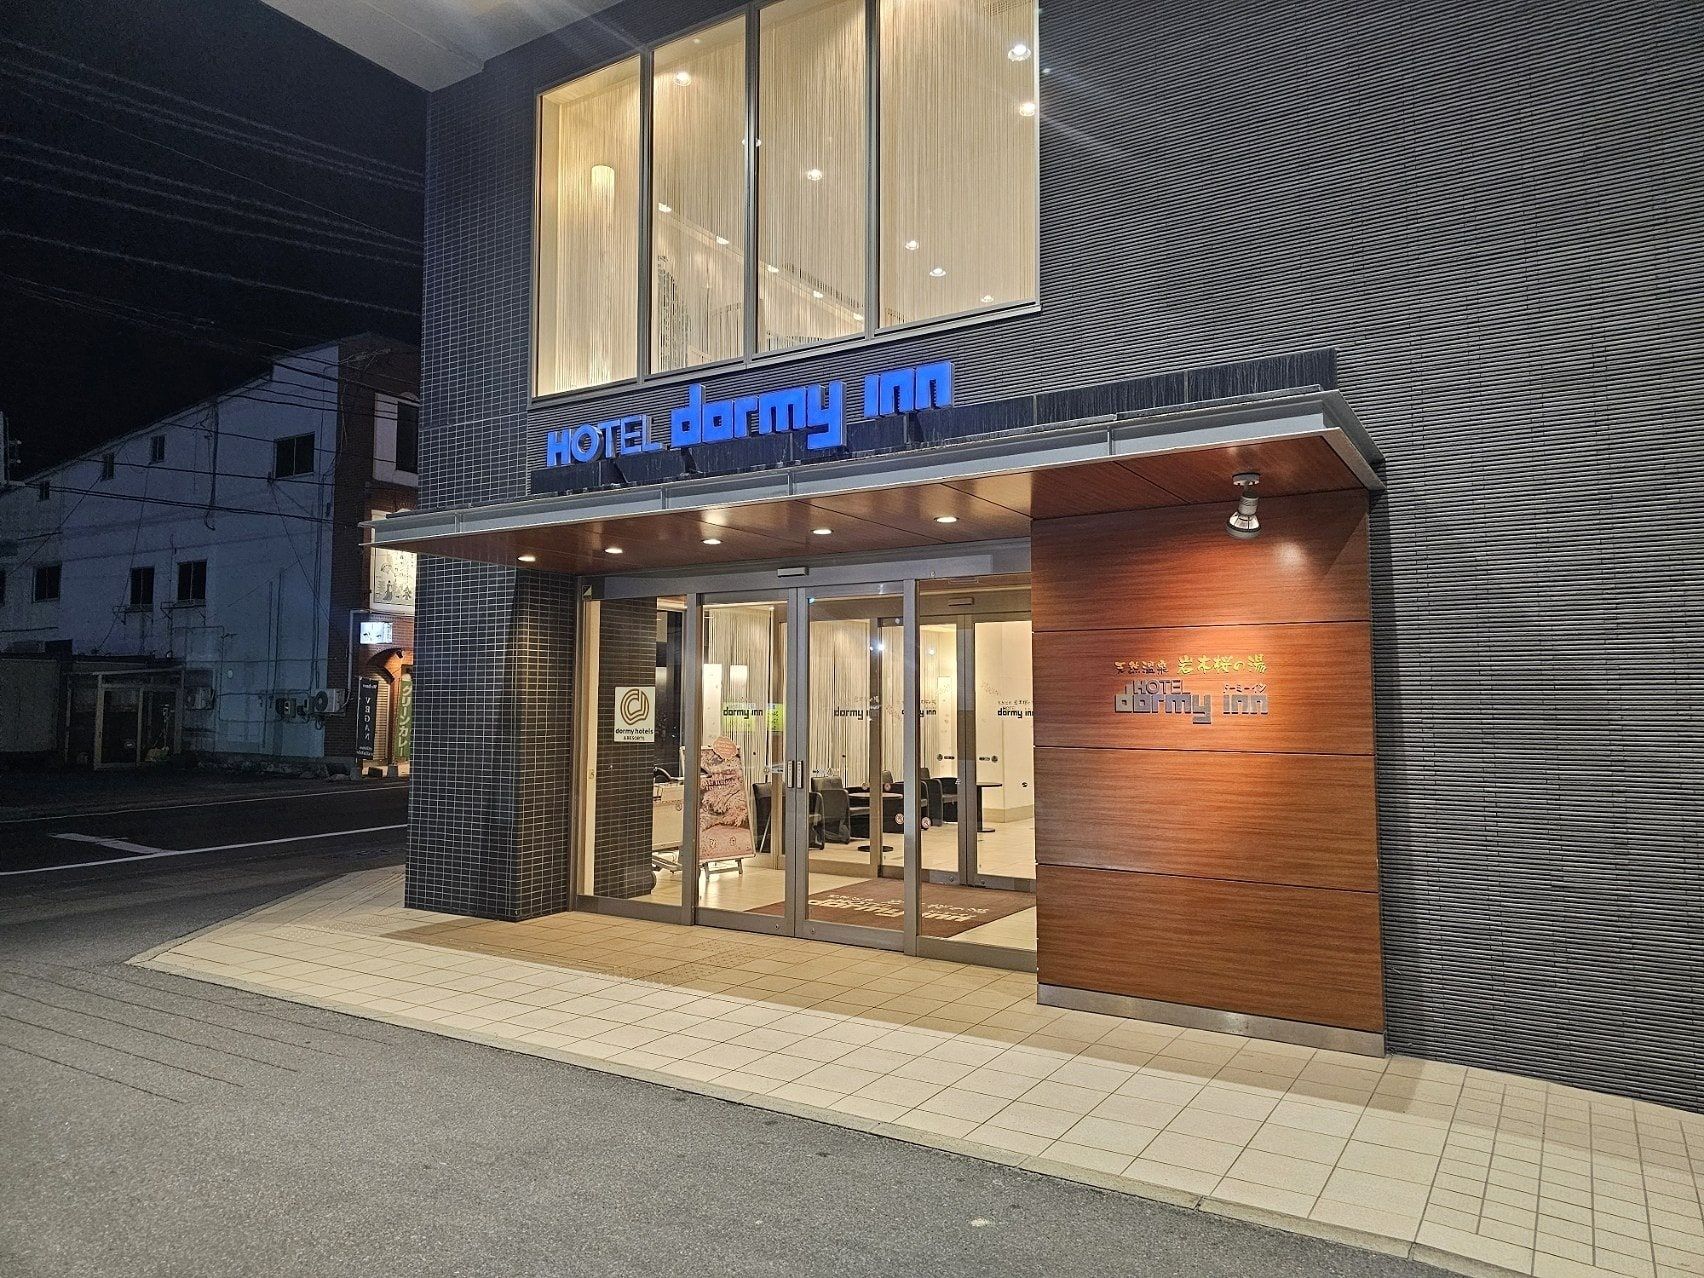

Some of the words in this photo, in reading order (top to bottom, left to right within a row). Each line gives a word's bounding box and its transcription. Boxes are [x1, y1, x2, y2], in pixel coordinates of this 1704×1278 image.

[547, 415, 666, 467] HOTEL
[671, 380, 847, 450] dormy
[864, 361, 954, 418] inn
[1133, 680, 1190, 694] HOTEL
[1115, 682, 1211, 724] dormy
[1223, 694, 1268, 714] inn
[723, 706, 750, 720] dormy
[751, 708, 763, 716] inn
[834, 706, 864, 720] dormy
[997, 707, 1023, 719] dormy
[399, 685, 413, 757] グリーンカレー
[615, 727, 634, 735] dormy
[634, 727, 654, 735] hotels
